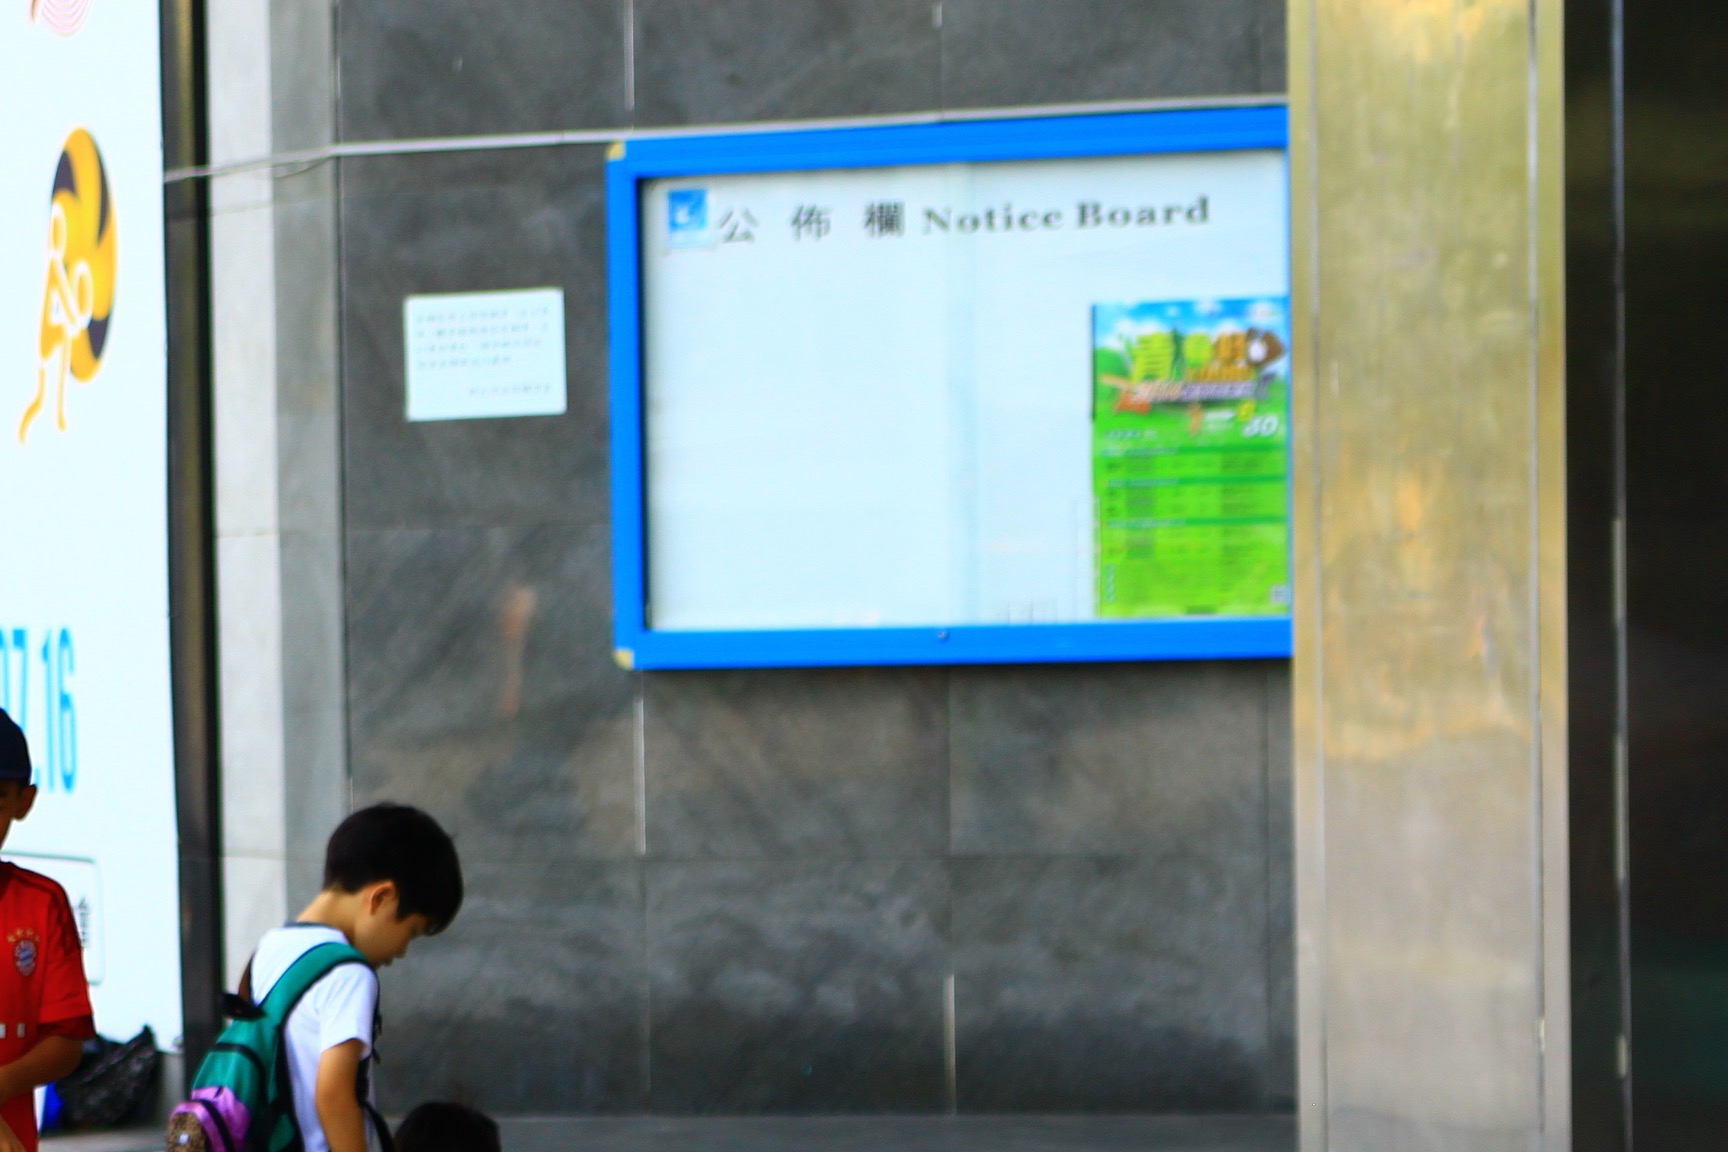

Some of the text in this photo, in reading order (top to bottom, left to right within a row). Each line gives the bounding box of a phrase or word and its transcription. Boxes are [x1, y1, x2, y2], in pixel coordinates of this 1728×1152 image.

[718, 195, 1210, 243] 公佈欄 Notice Board
